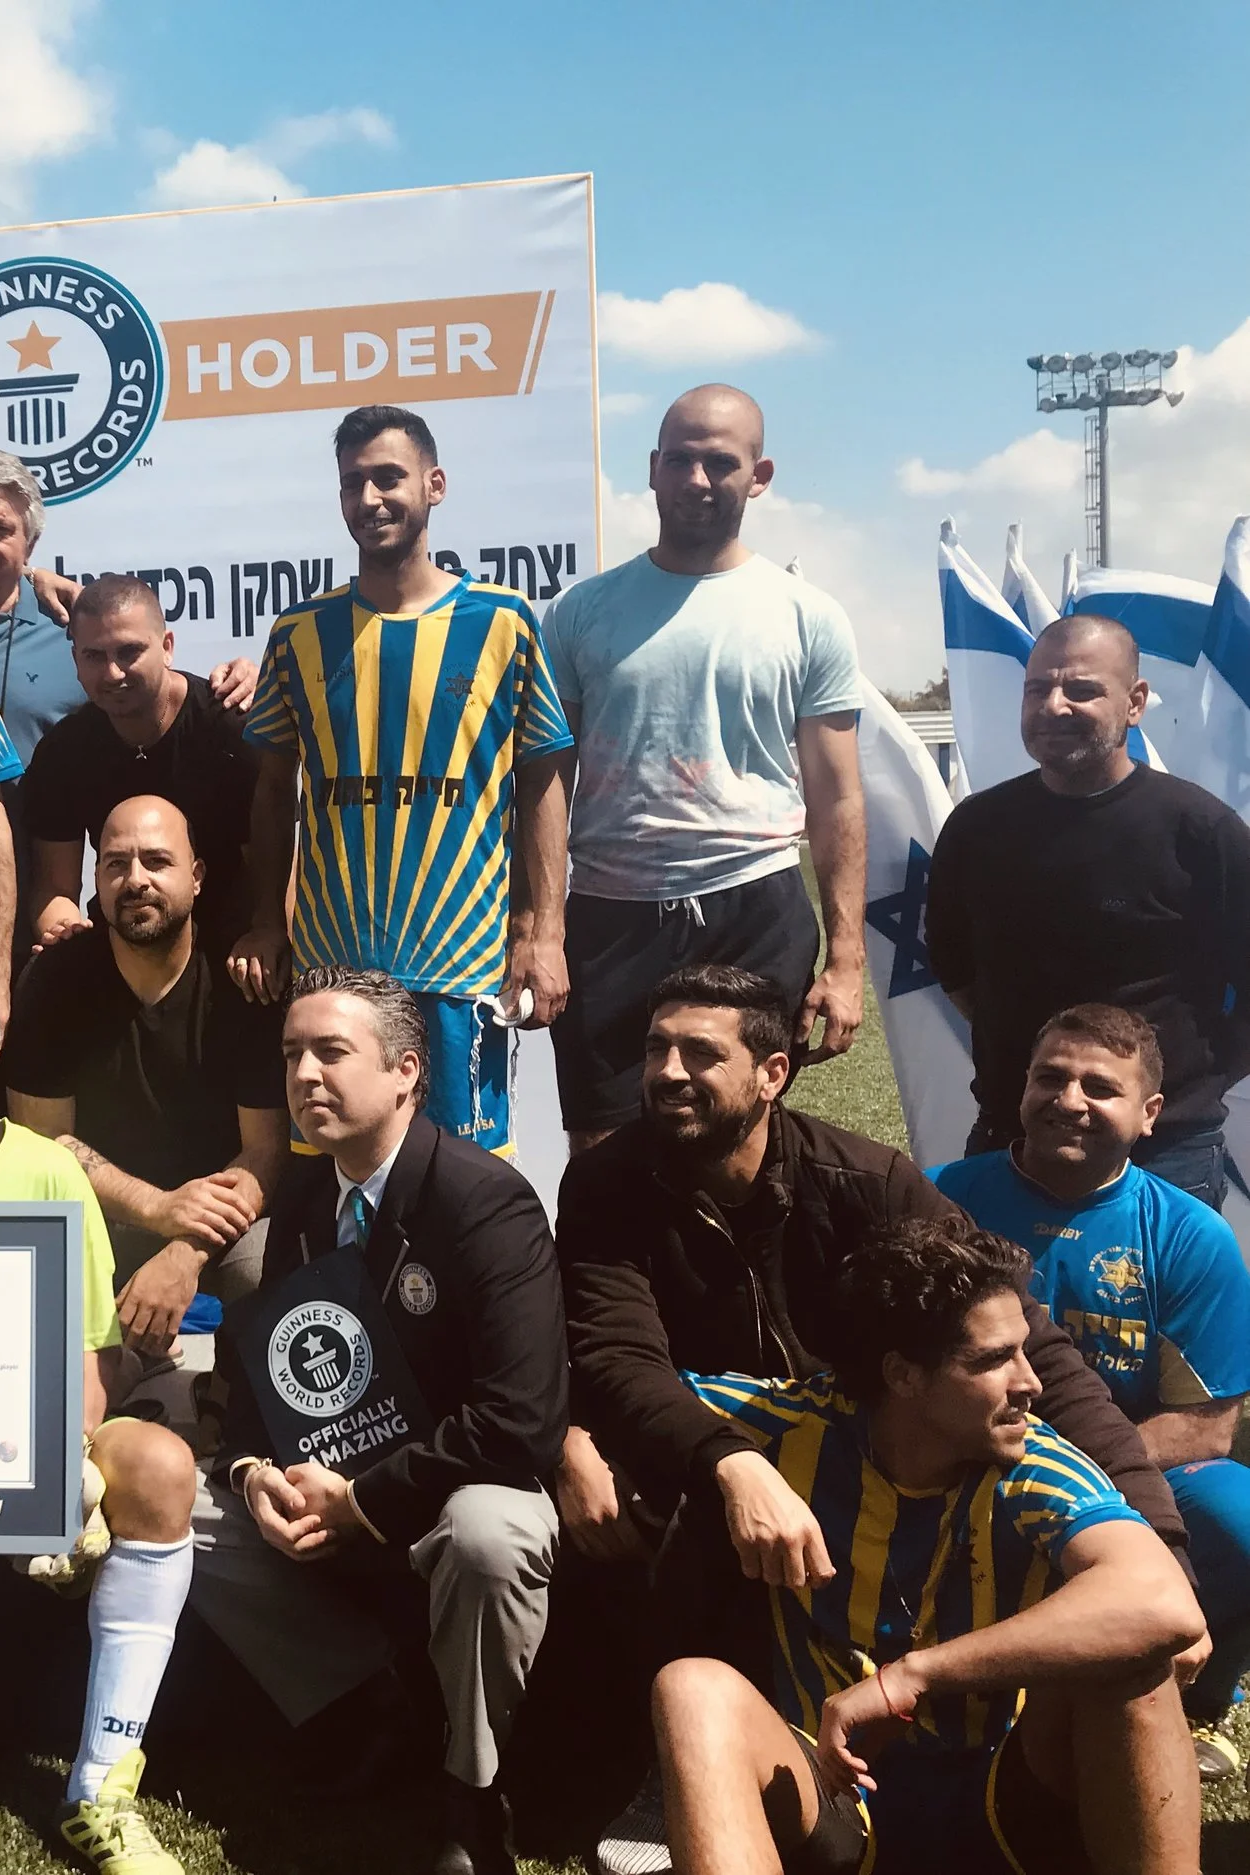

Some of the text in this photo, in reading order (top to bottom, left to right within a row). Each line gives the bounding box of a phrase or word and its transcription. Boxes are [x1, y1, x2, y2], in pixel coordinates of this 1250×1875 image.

[187, 322, 497, 394] HOLDER
[27, 358, 146, 491] RECORDS
[232, 557, 333, 637] שחקן
[276, 1308, 344, 1353] GUINNESS
[278, 1333, 366, 1408] WORLD RECORDS
[298, 1396, 398, 1453] OFFICIALLY
[308, 1414, 409, 1469] AMAZING
